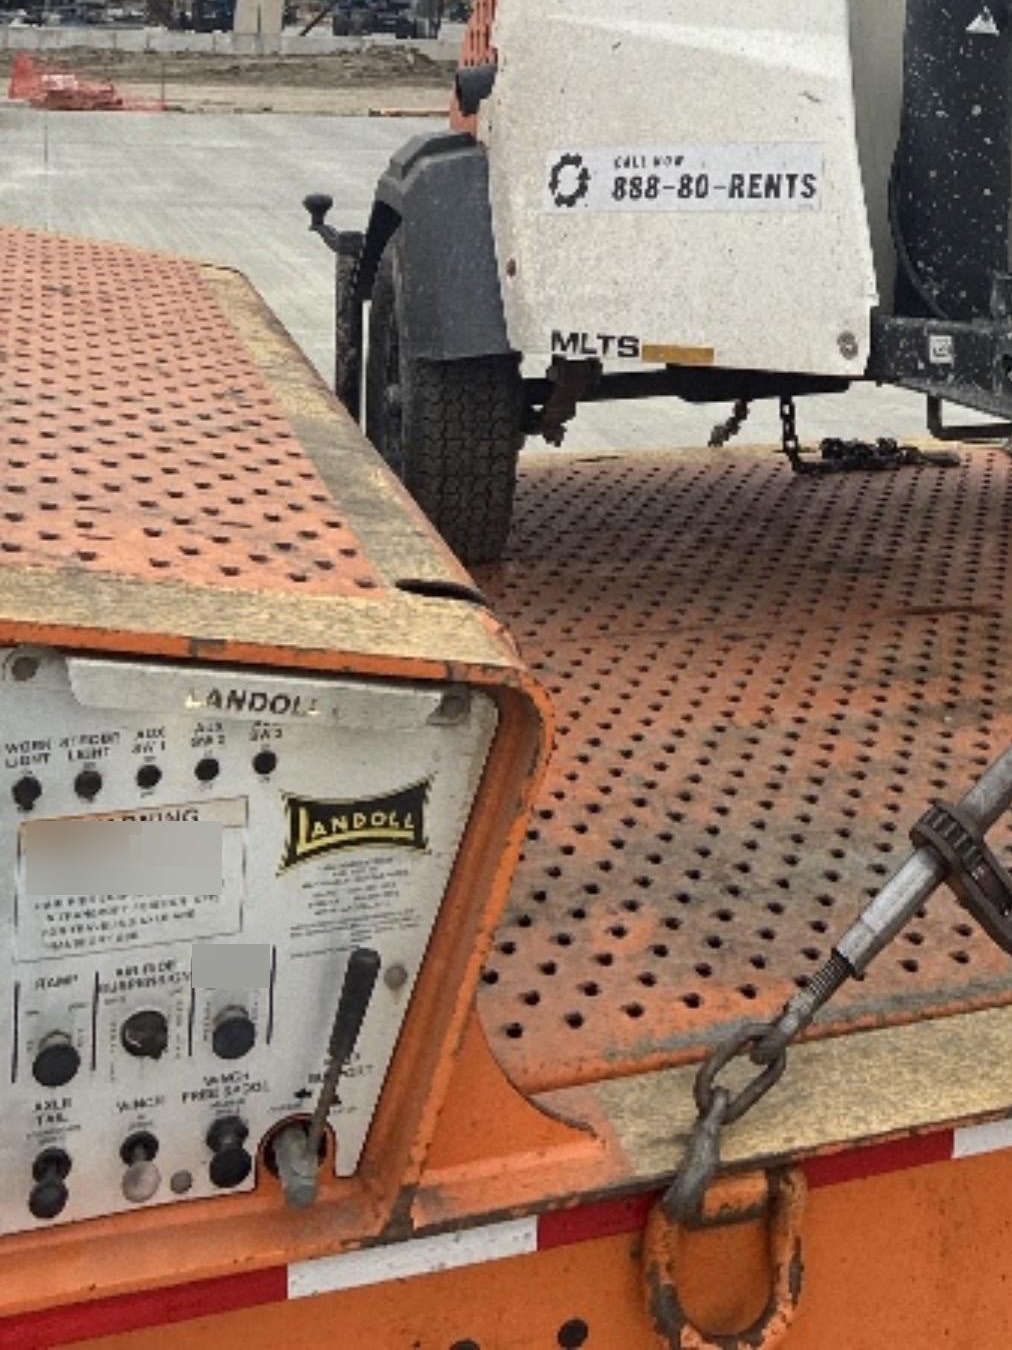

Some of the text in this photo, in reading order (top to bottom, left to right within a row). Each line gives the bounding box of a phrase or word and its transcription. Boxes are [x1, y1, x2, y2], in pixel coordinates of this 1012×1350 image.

[612, 173, 817, 200] 888-80-RENTS
[551, 330, 640, 358] MLTS
[298, 806, 415, 854] LANDOLL
